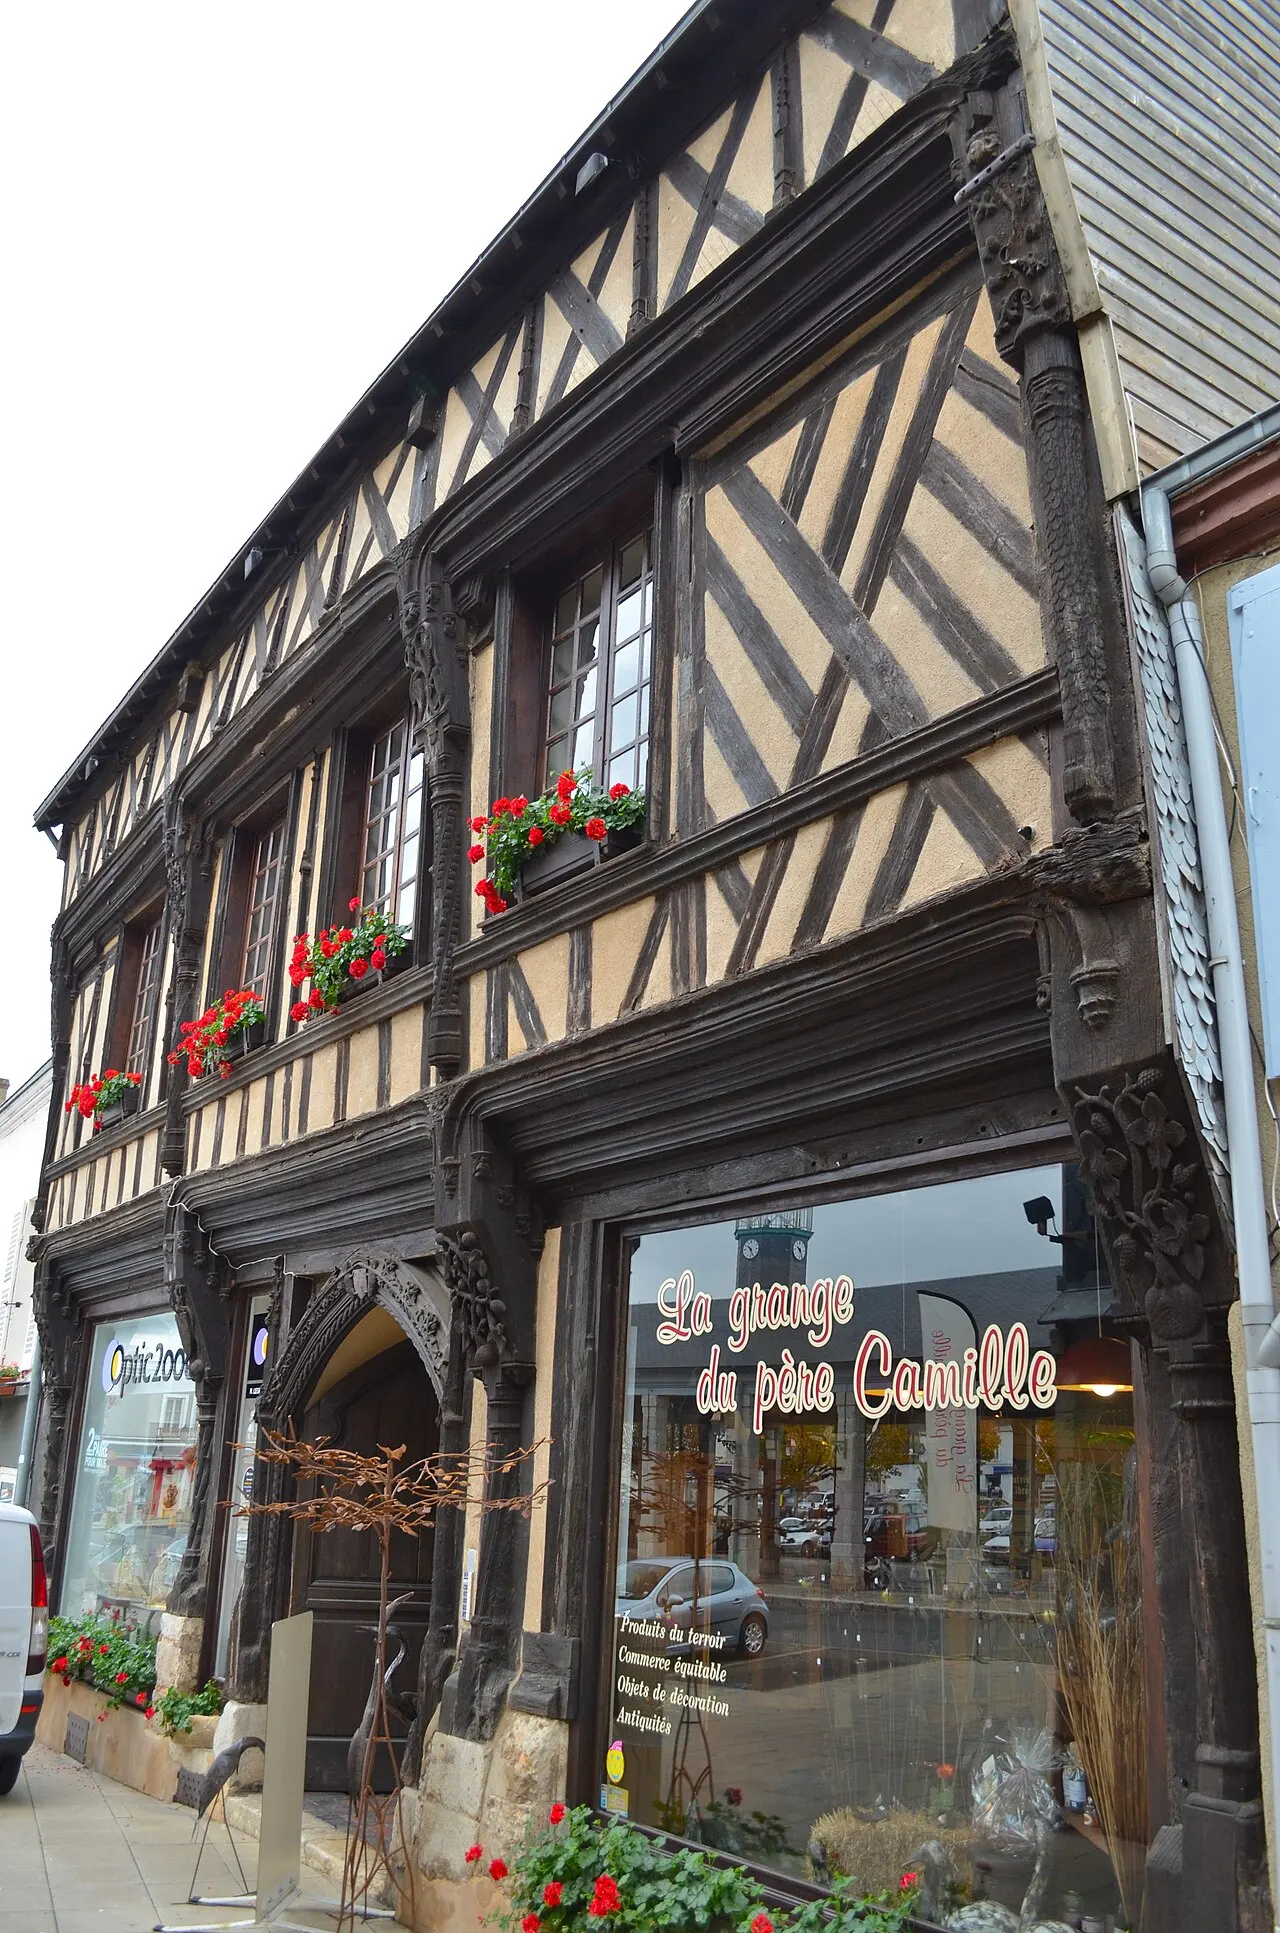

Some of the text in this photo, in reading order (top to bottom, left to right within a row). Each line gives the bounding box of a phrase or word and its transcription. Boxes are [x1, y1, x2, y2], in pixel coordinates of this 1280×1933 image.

[656, 1269, 854, 1353] La grange
[696, 1322, 1057, 1435] du père Camille
[620, 1616, 726, 1649] Produits du terroir
[618, 1645, 727, 1683] Commerce équitable
[617, 1674, 730, 1716] Objets de décoration
[616, 1706, 672, 1735] Antiquités
